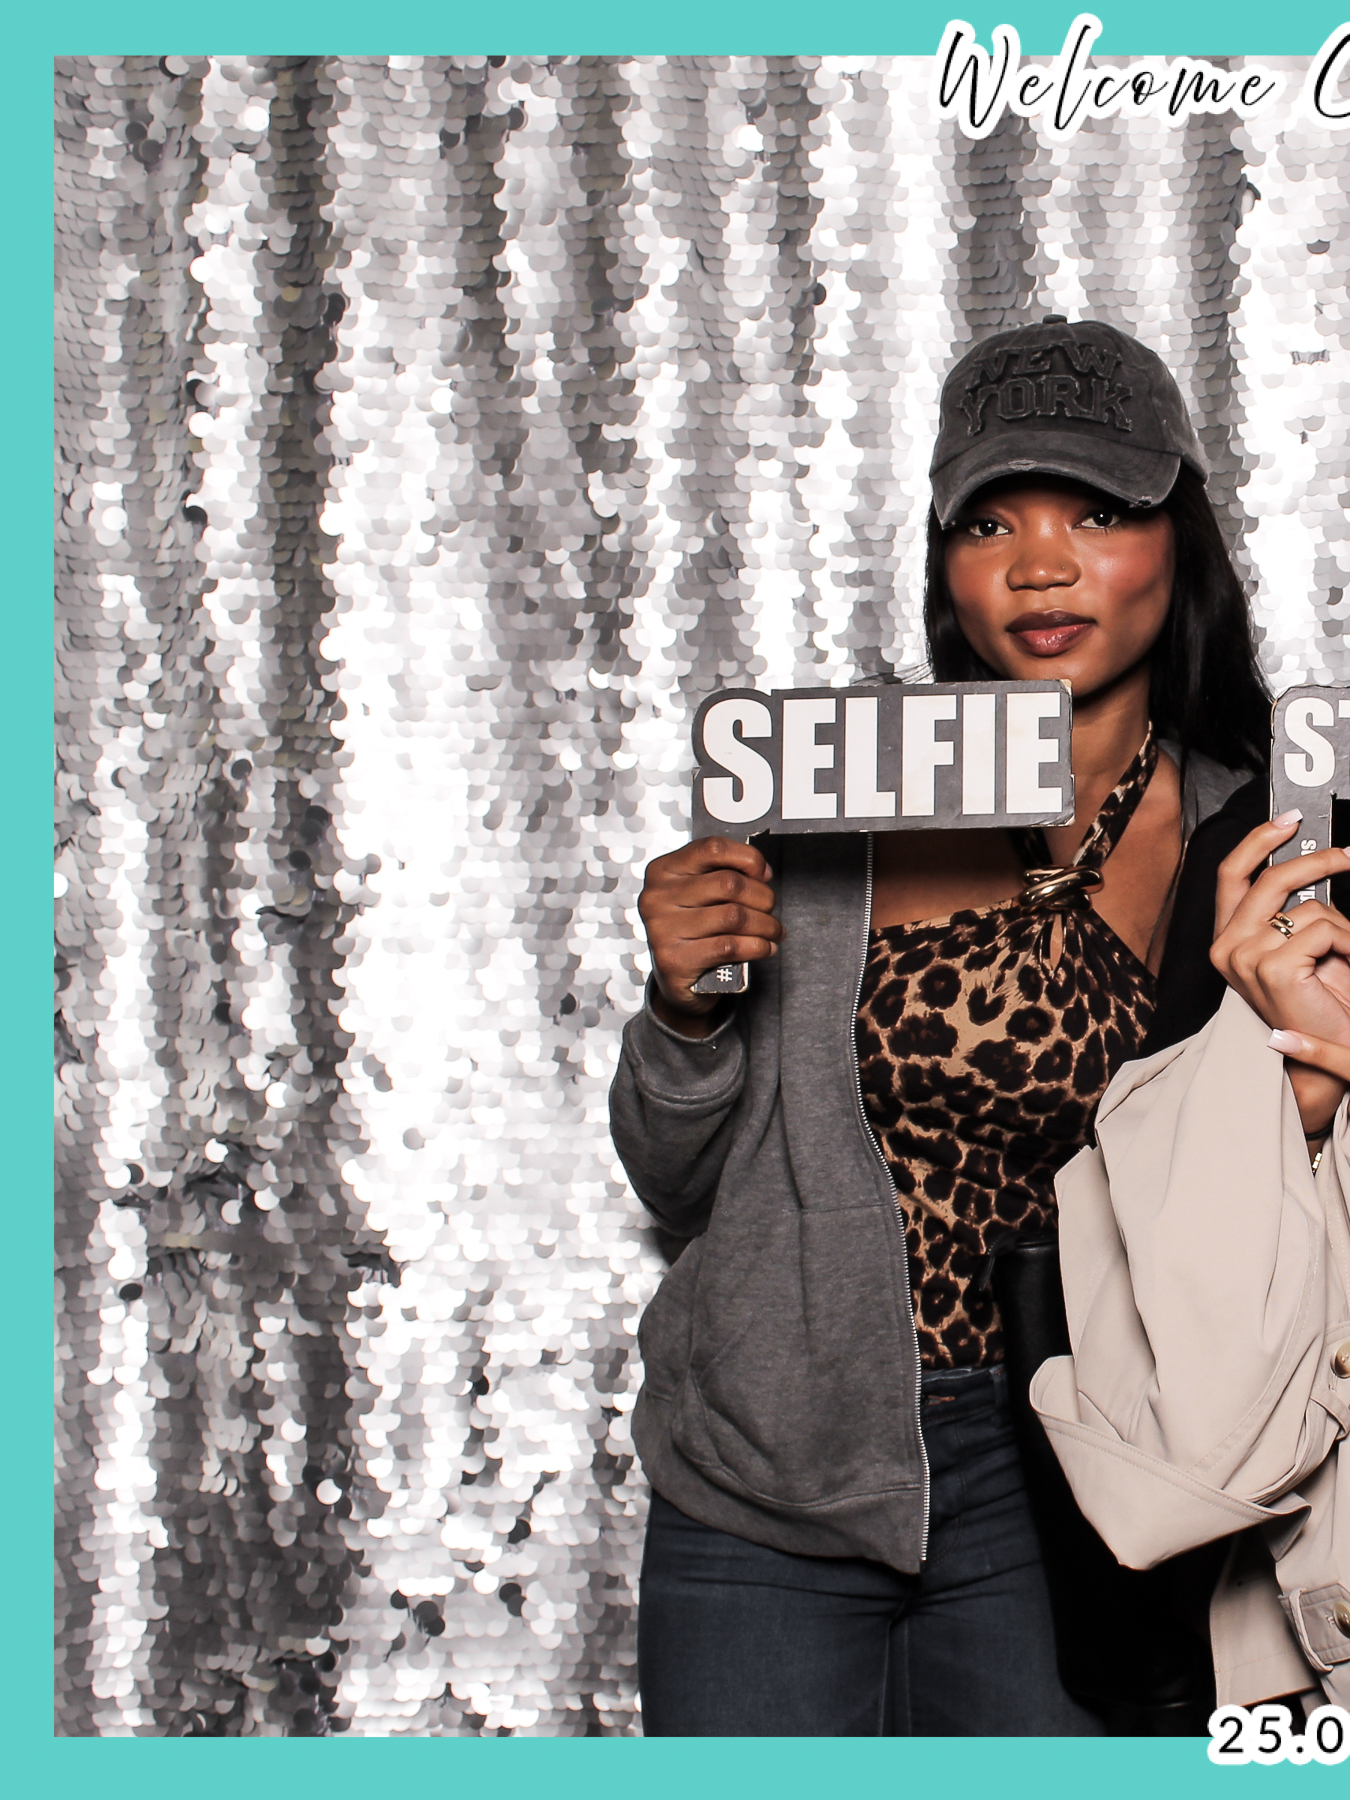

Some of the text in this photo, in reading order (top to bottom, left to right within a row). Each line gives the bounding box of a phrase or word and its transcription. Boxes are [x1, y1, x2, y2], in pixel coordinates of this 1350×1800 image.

[965, 340, 1123, 391] NEW
[957, 374, 1133, 437] YORK
[702, 691, 1063, 824] SELFIE
